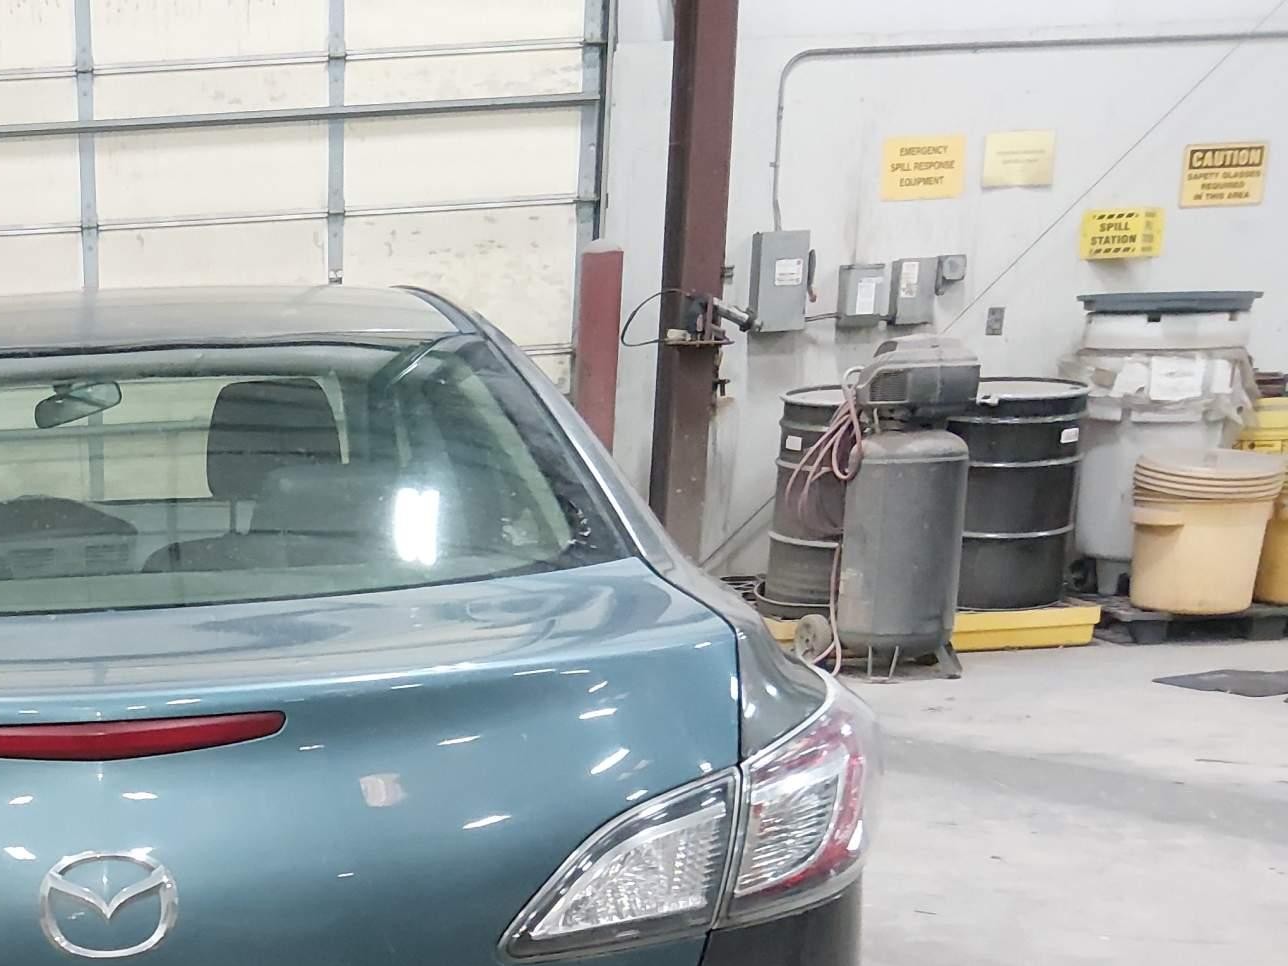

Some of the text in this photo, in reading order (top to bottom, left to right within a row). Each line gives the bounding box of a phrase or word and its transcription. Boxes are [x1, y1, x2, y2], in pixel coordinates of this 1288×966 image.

[899, 145, 948, 156] EMERGENCY
[1192, 148, 1261, 167] CAUTION
[891, 160, 955, 172] SPILL RESPONSE
[1187, 170, 1261, 181] SAFETY GLASSES
[899, 176, 944, 187] EQUIPMENT
[1201, 181, 1245, 190] REQUIRED
[1206, 192, 1224, 200] THIS
[1227, 191, 1250, 199] AREA
[1099, 221, 1130, 233] SPILL
[1090, 234, 1137, 246] STATION
